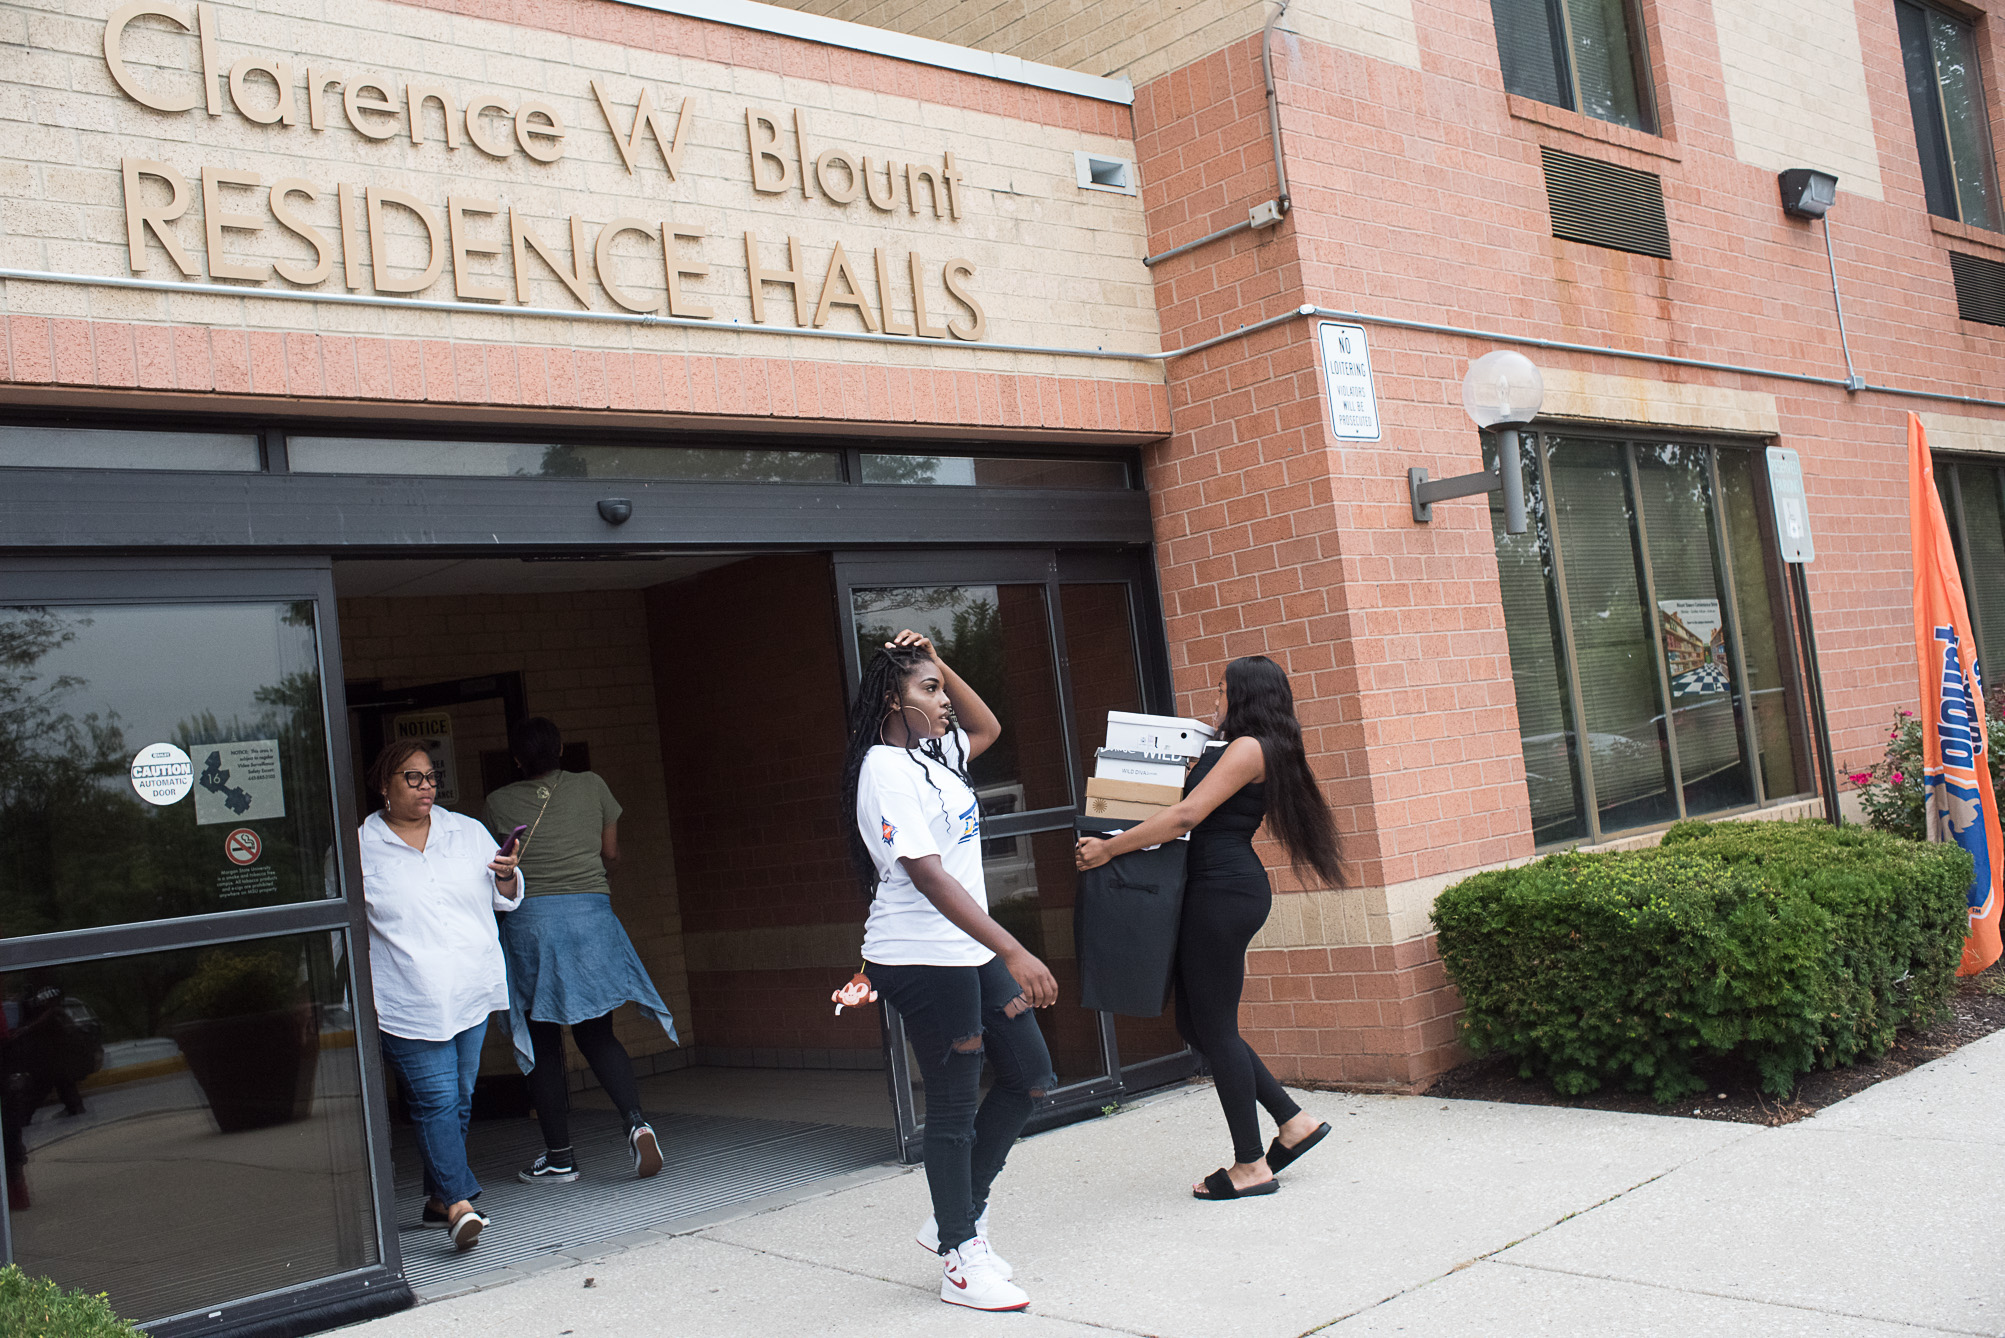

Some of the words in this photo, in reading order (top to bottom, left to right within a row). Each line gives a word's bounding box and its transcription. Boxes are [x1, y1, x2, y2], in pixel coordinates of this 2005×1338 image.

[104, 4, 566, 163] Clarence
[589, 80, 696, 182] W
[745, 107, 964, 220] Blount
[121, 157, 714, 319] RESIDENCE
[745, 231, 987, 341] HALLS
[1338, 337, 1352, 354] NO
[1330, 361, 1366, 377] LOITERING
[1337, 385, 1366, 398] VIOLATORS
[1343, 401, 1356, 412] WILL
[1357, 401, 1365, 412] BE
[1339, 415, 1372, 427] PROSECUTED
[399, 720, 447, 737] NOTICE
[1143, 751, 1182, 762] WILD
[132, 763, 192, 778] CAUTION
[139, 777, 188, 788] AUTOMATIC
[208, 773, 221, 785] 16
[152, 789, 176, 797] DOOR
